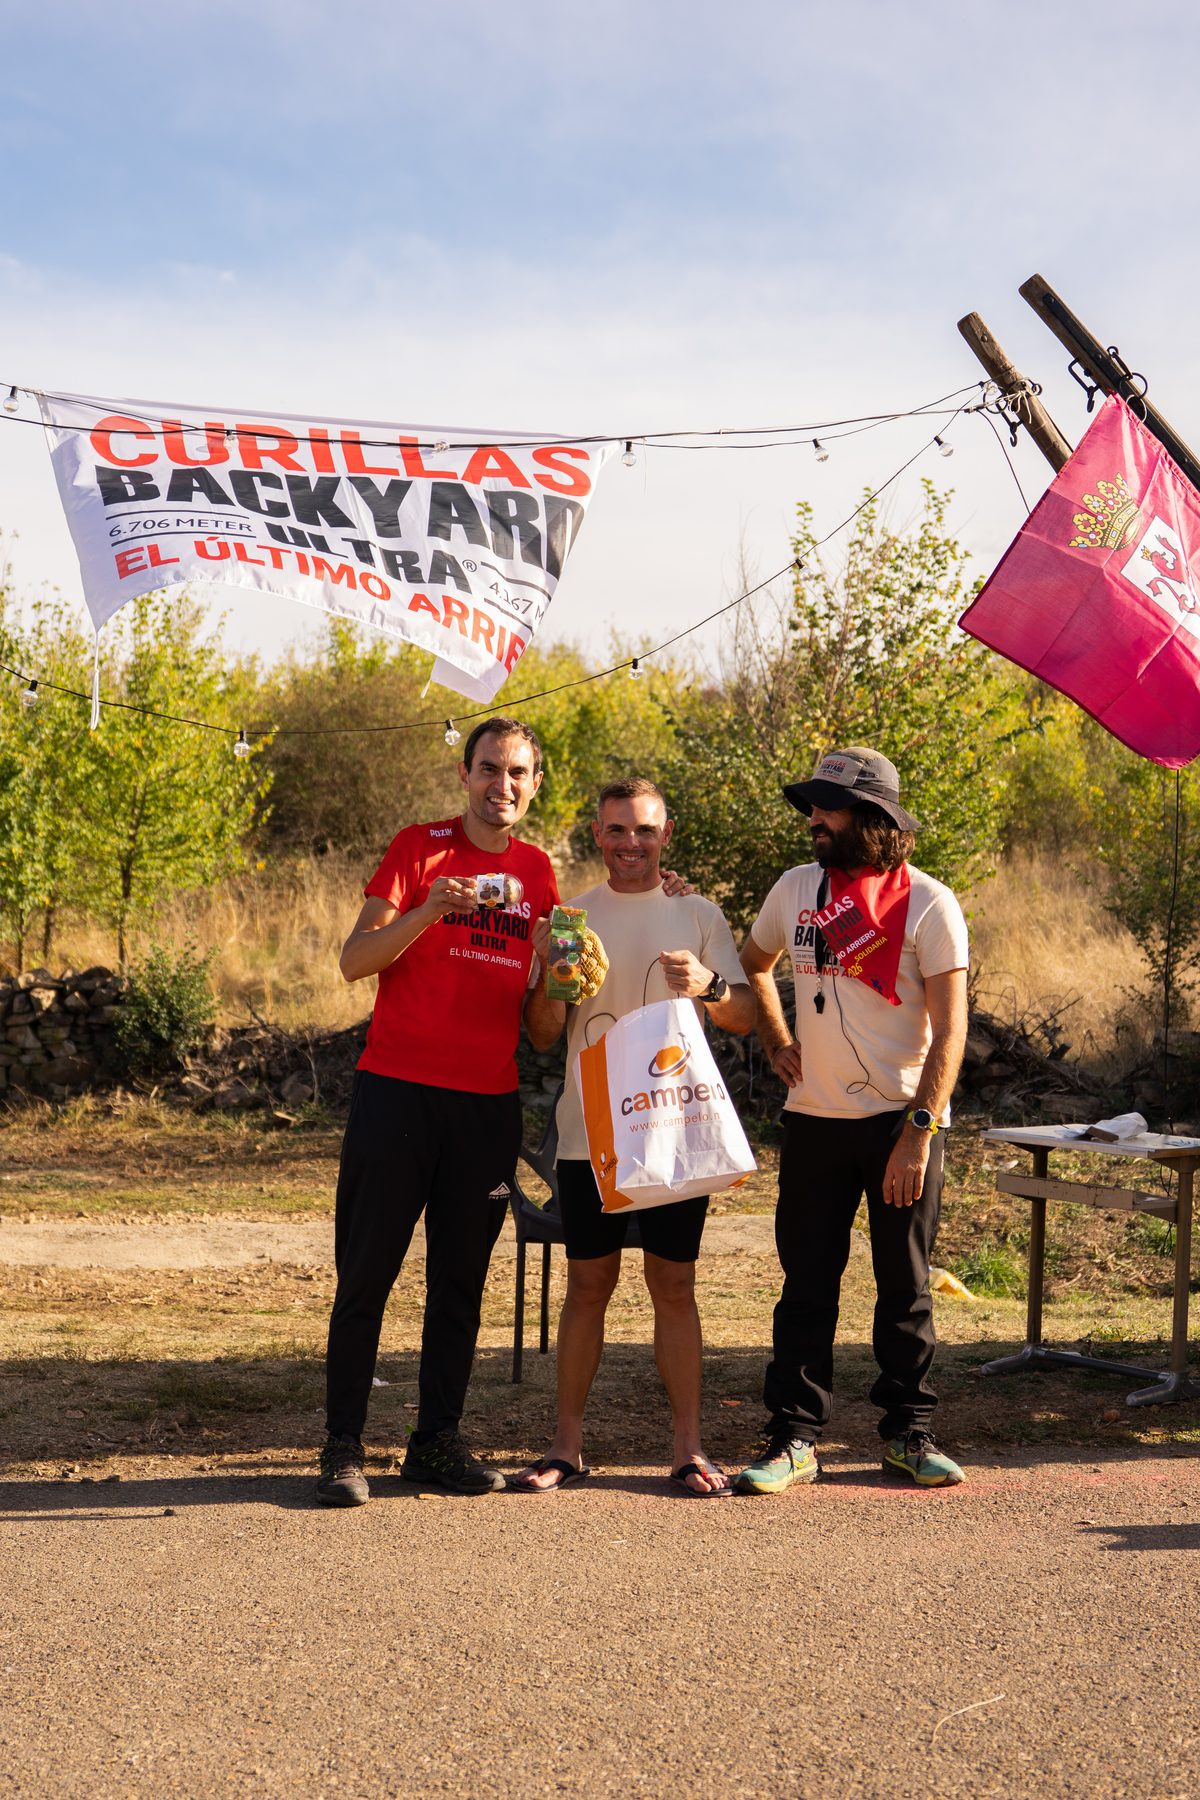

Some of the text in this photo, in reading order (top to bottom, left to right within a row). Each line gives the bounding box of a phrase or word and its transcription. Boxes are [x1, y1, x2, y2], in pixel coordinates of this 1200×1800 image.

[90, 415, 593, 497] CURILLAS
[109, 518, 253, 537] 6.706 METER
[114, 544, 181, 580] EL
[193, 537, 392, 601] ÚLTIMO
[489, 582, 534, 615] 4.167
[471, 931, 507, 953] ULTRA
[846, 929, 876, 954] ARRIERO
[854, 936, 888, 963] SOLIDARIA
[449, 947, 522, 969] EL ÚLTIMO ARRIERO
[621, 1083, 726, 1116] campelo
